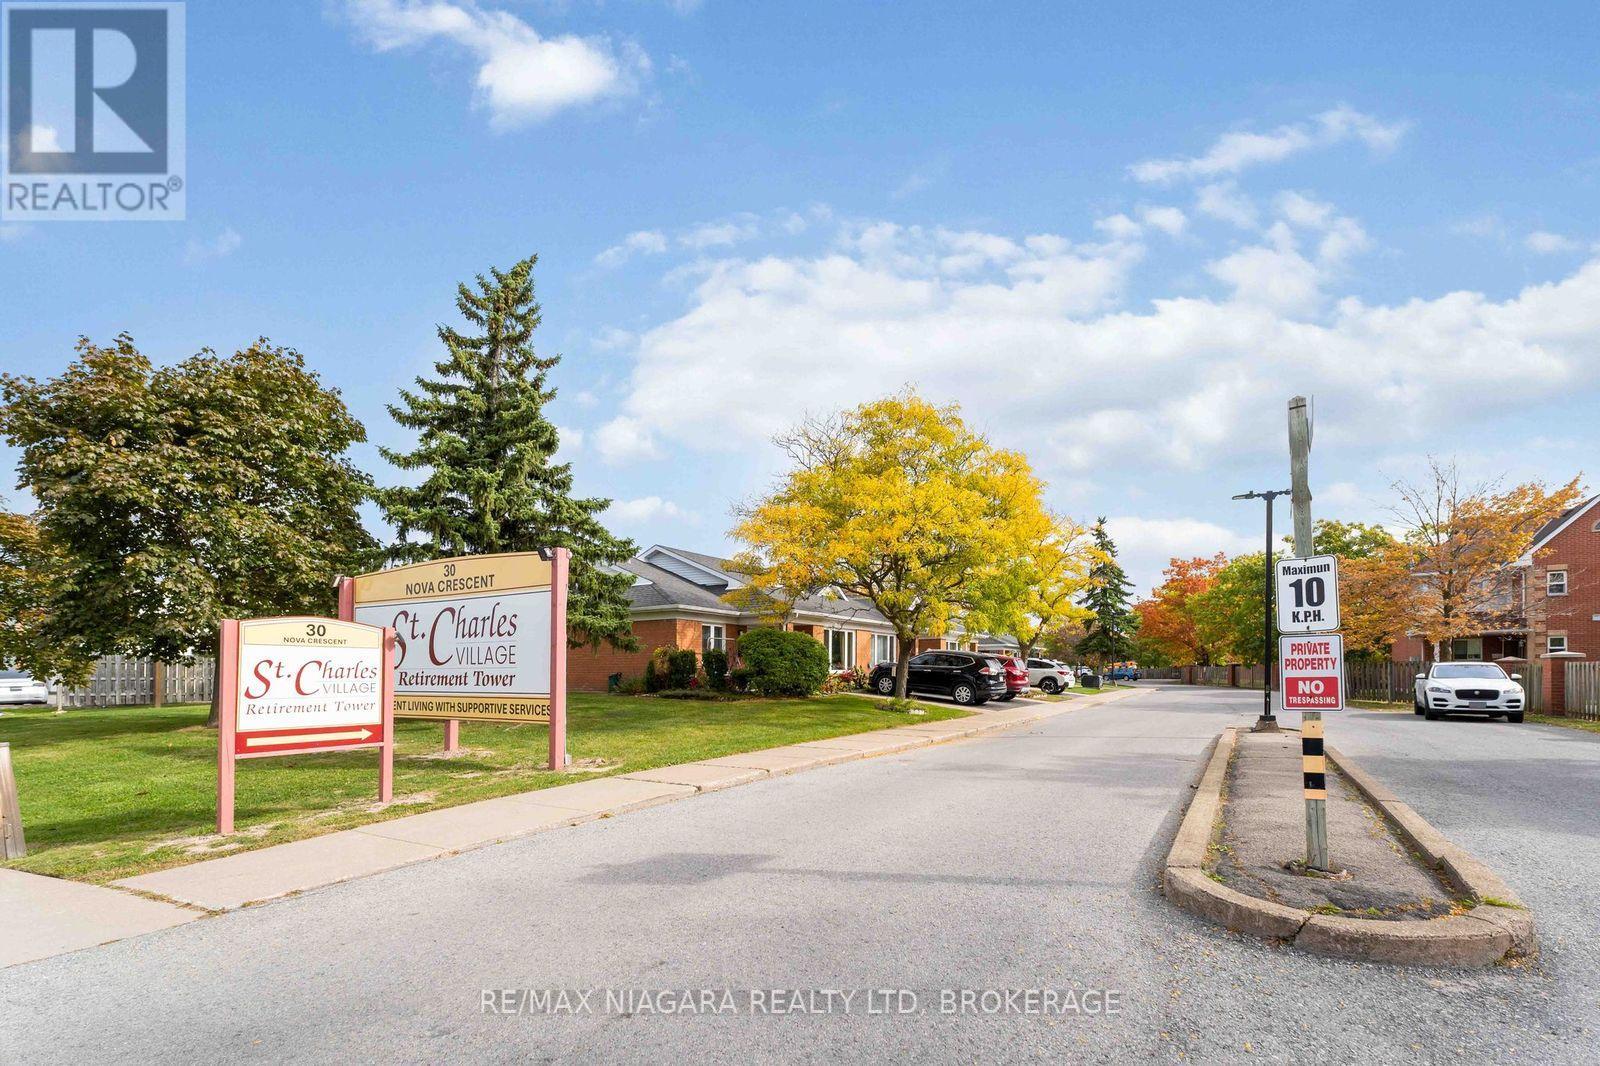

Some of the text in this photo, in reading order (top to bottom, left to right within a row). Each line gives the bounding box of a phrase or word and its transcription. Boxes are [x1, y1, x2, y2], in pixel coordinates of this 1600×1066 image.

[443, 564, 456, 577] 30
[405, 574, 495, 596] NOVA CRESCENT
[1289, 577, 1325, 608] 10
[1292, 610, 1325, 623] K.P.H.
[306, 624, 327, 637] 30
[392, 602, 518, 670] St. Charles
[283, 637, 306, 645] NOVA
[456, 645, 516, 665] VILLAGE
[1290, 642, 1330, 655] PRIVATE
[1284, 658, 1337, 671] PROPERTY
[244, 659, 377, 699] St. Charles
[398, 670, 516, 687] Retirement Tower
[322, 682, 376, 694] VILLAGE
[1298, 680, 1325, 694] NO
[246, 700, 376, 715] Retirement Tower
[1289, 696, 1336, 705] TRESPASSING
[408, 701, 434, 712] LIVING
[435, 702, 456, 713] WITH
[457, 702, 508, 715] SUPPORTIVE
[509, 704, 550, 717] SERVICES
